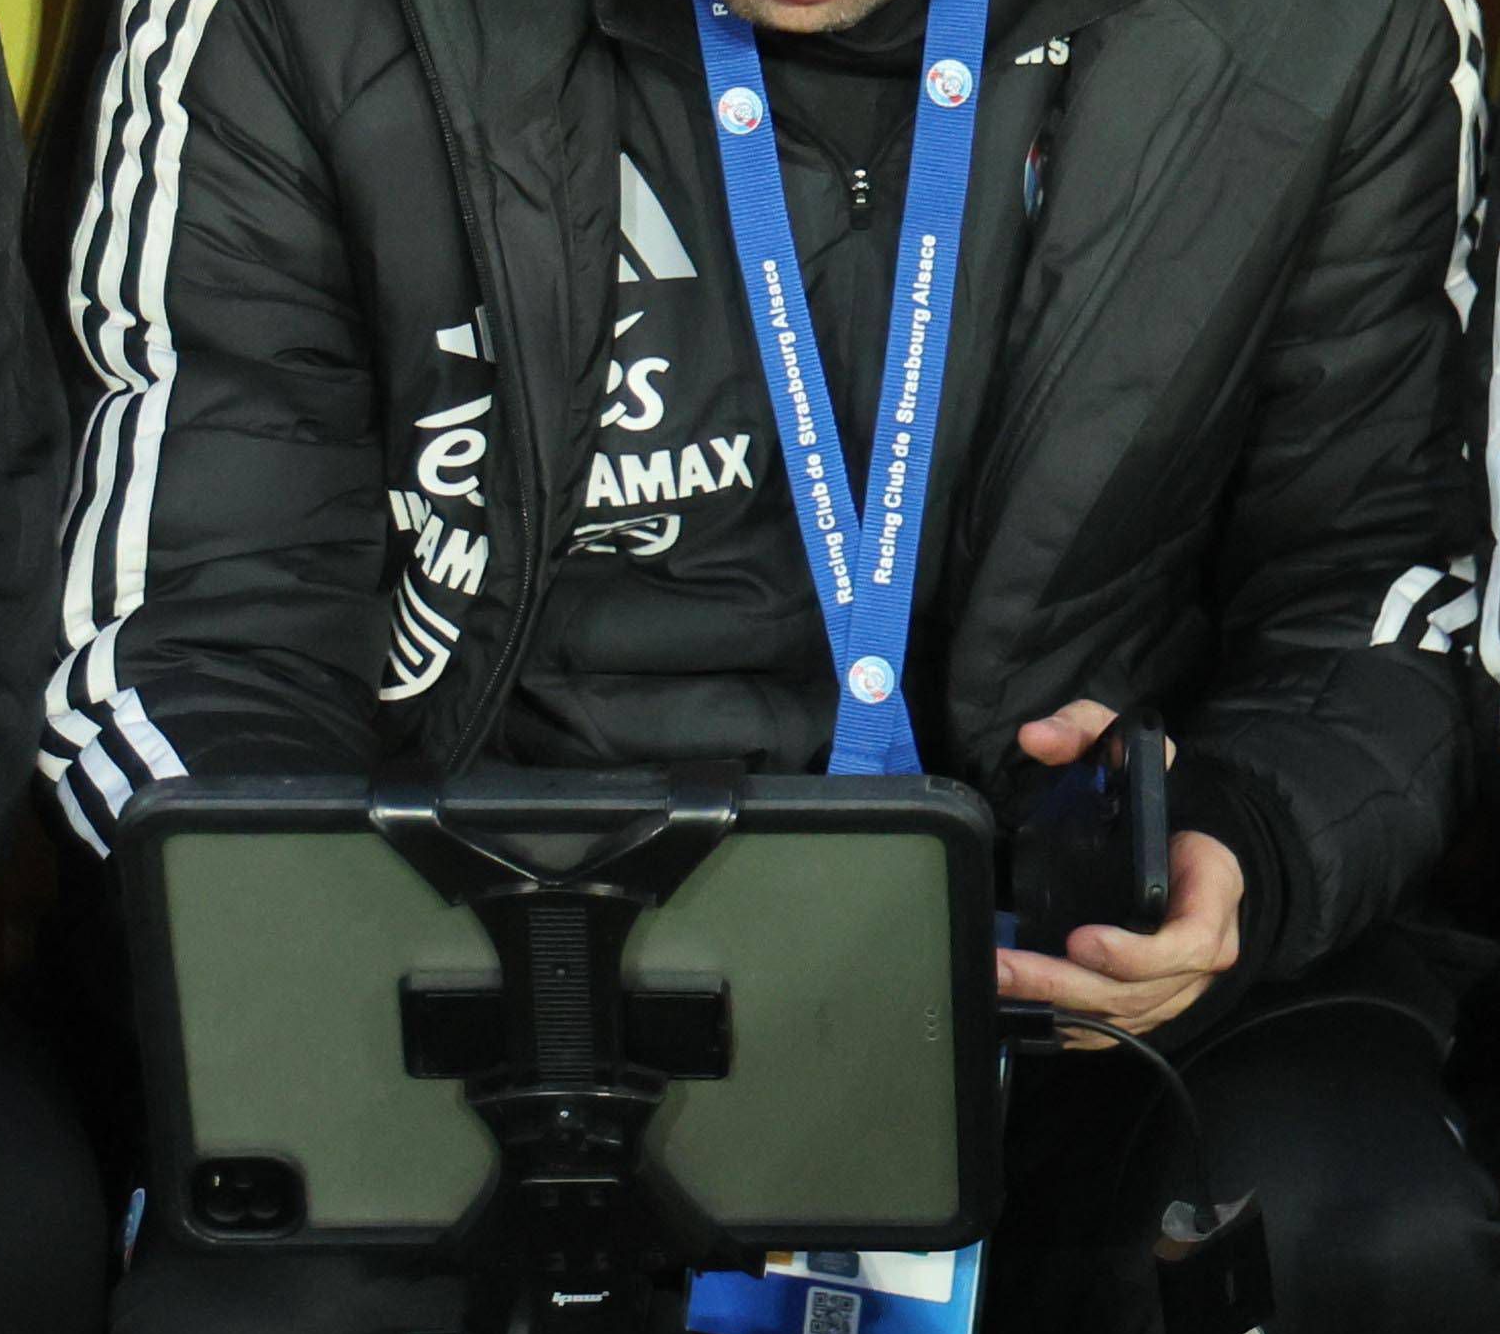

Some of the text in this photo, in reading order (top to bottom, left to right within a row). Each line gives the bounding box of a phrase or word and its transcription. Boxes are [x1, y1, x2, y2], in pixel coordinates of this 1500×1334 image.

[585, 434, 753, 508] AMAX
[762, 259, 854, 605] Racing Club de Strasbourg Alsace
[873, 234, 937, 585] Racing Club de Strasbourg Alsace
